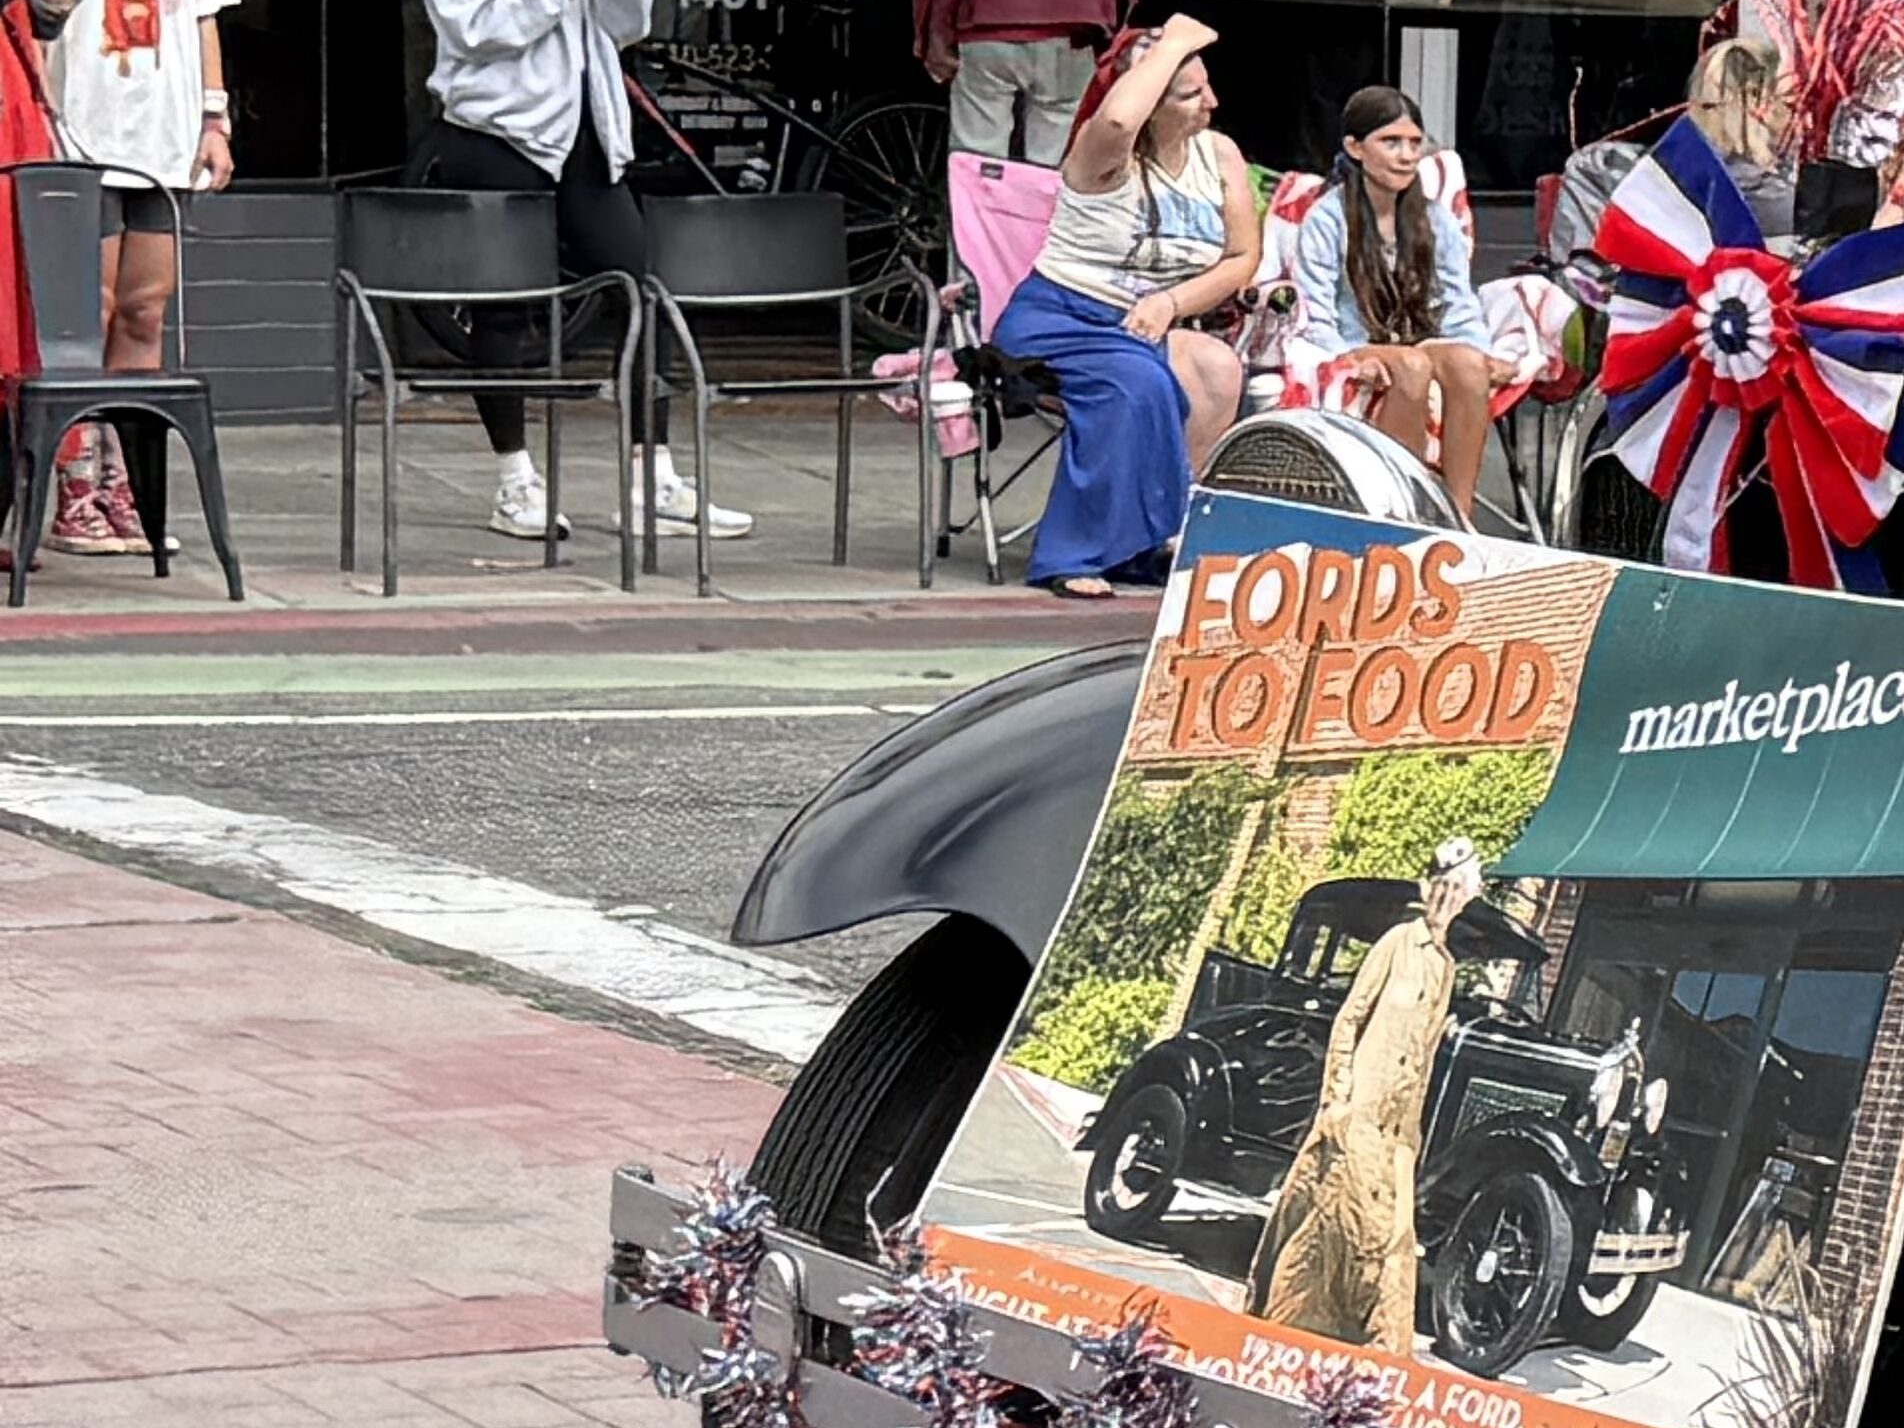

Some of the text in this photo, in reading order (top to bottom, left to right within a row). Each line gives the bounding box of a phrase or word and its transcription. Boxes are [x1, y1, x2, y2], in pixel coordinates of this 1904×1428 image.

[1179, 540, 1466, 651] FORDS
[1169, 639, 1555, 751] TO FOOD
[1241, 1333, 1305, 1372] 1930
[1413, 1377, 1436, 1412] A
